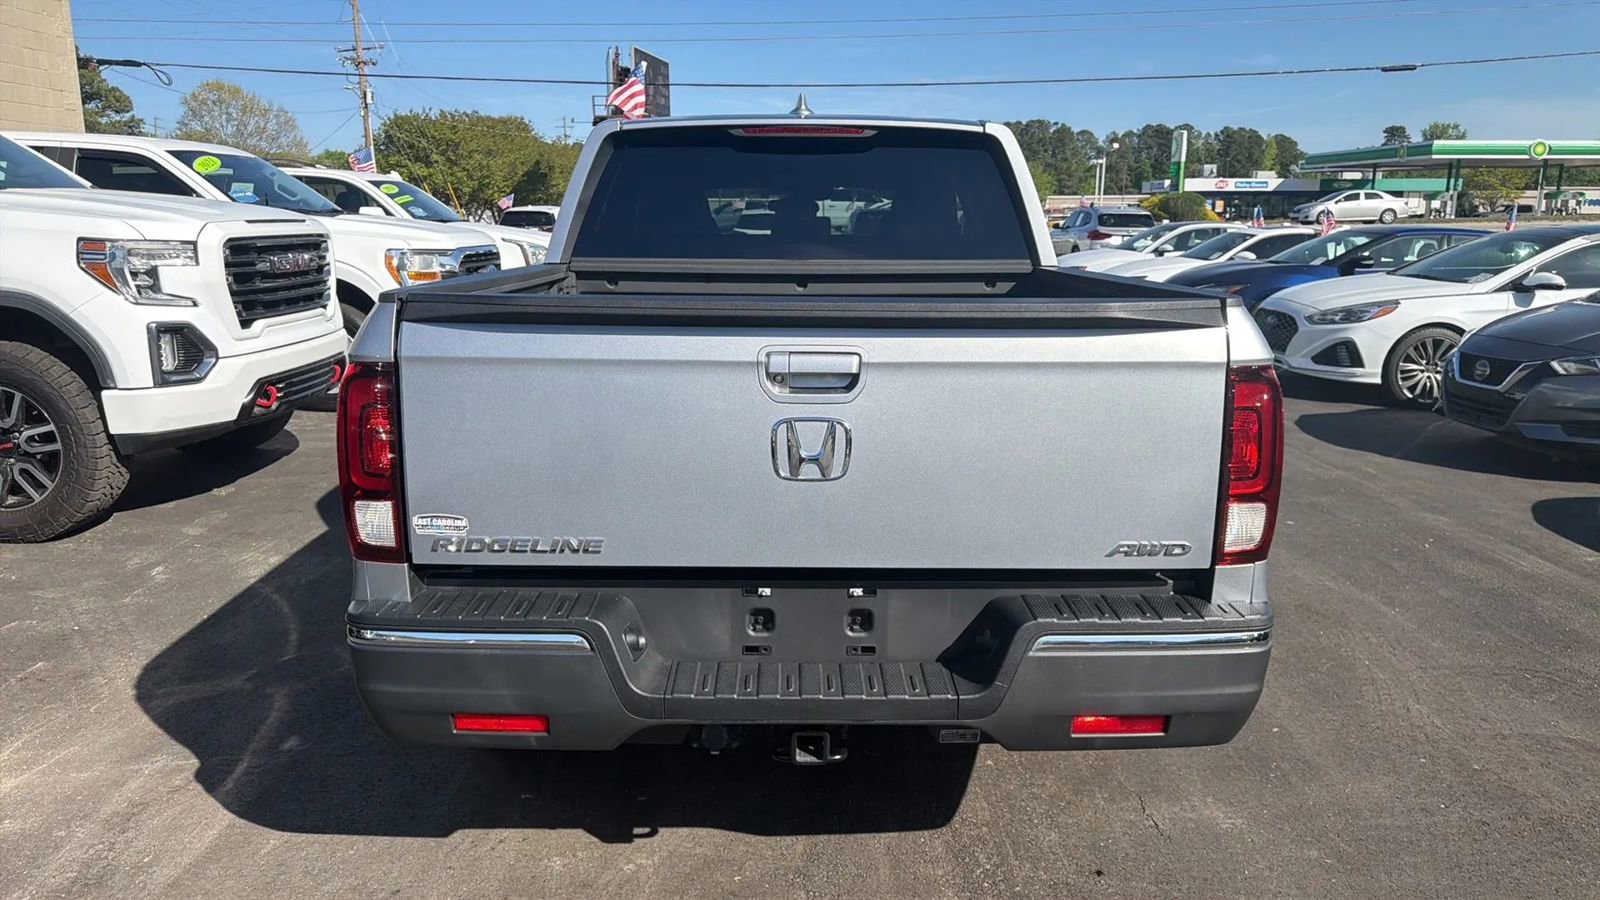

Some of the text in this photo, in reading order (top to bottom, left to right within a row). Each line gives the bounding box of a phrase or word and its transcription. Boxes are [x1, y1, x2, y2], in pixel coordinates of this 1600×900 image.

[272, 253, 319, 273] GMC
[432, 517, 467, 526] CAROLINA
[430, 536, 605, 555] RIDGELINE
[1104, 541, 1192, 557] AWD
